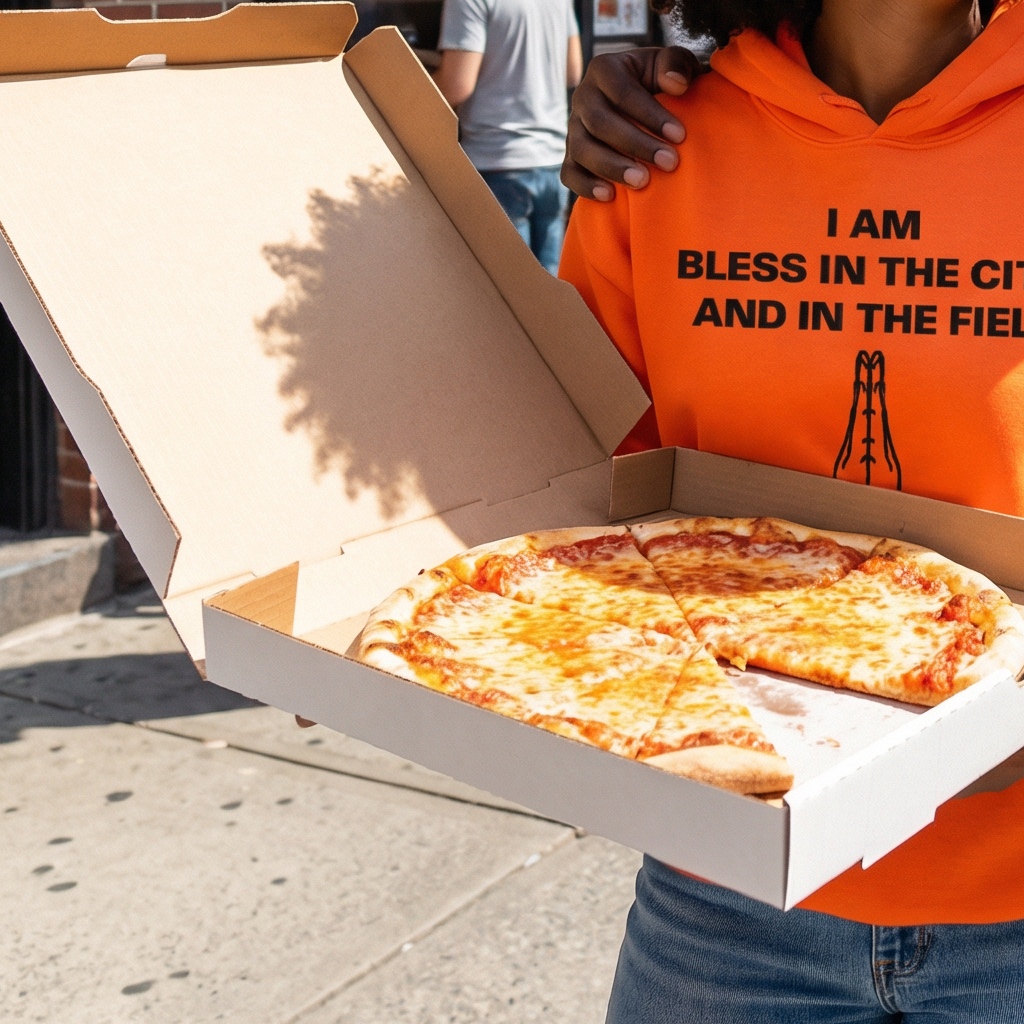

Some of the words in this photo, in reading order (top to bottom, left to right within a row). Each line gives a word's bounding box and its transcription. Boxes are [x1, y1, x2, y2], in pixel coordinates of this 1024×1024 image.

[827, 208, 838, 238] I
[849, 209, 921, 240] AM
[677, 249, 807, 283] BLESS
[820, 255, 866, 285] IN
[879, 256, 959, 288] THE
[692, 298, 787, 329] AND
[799, 301, 844, 331] IN
[857, 303, 938, 334] THE
